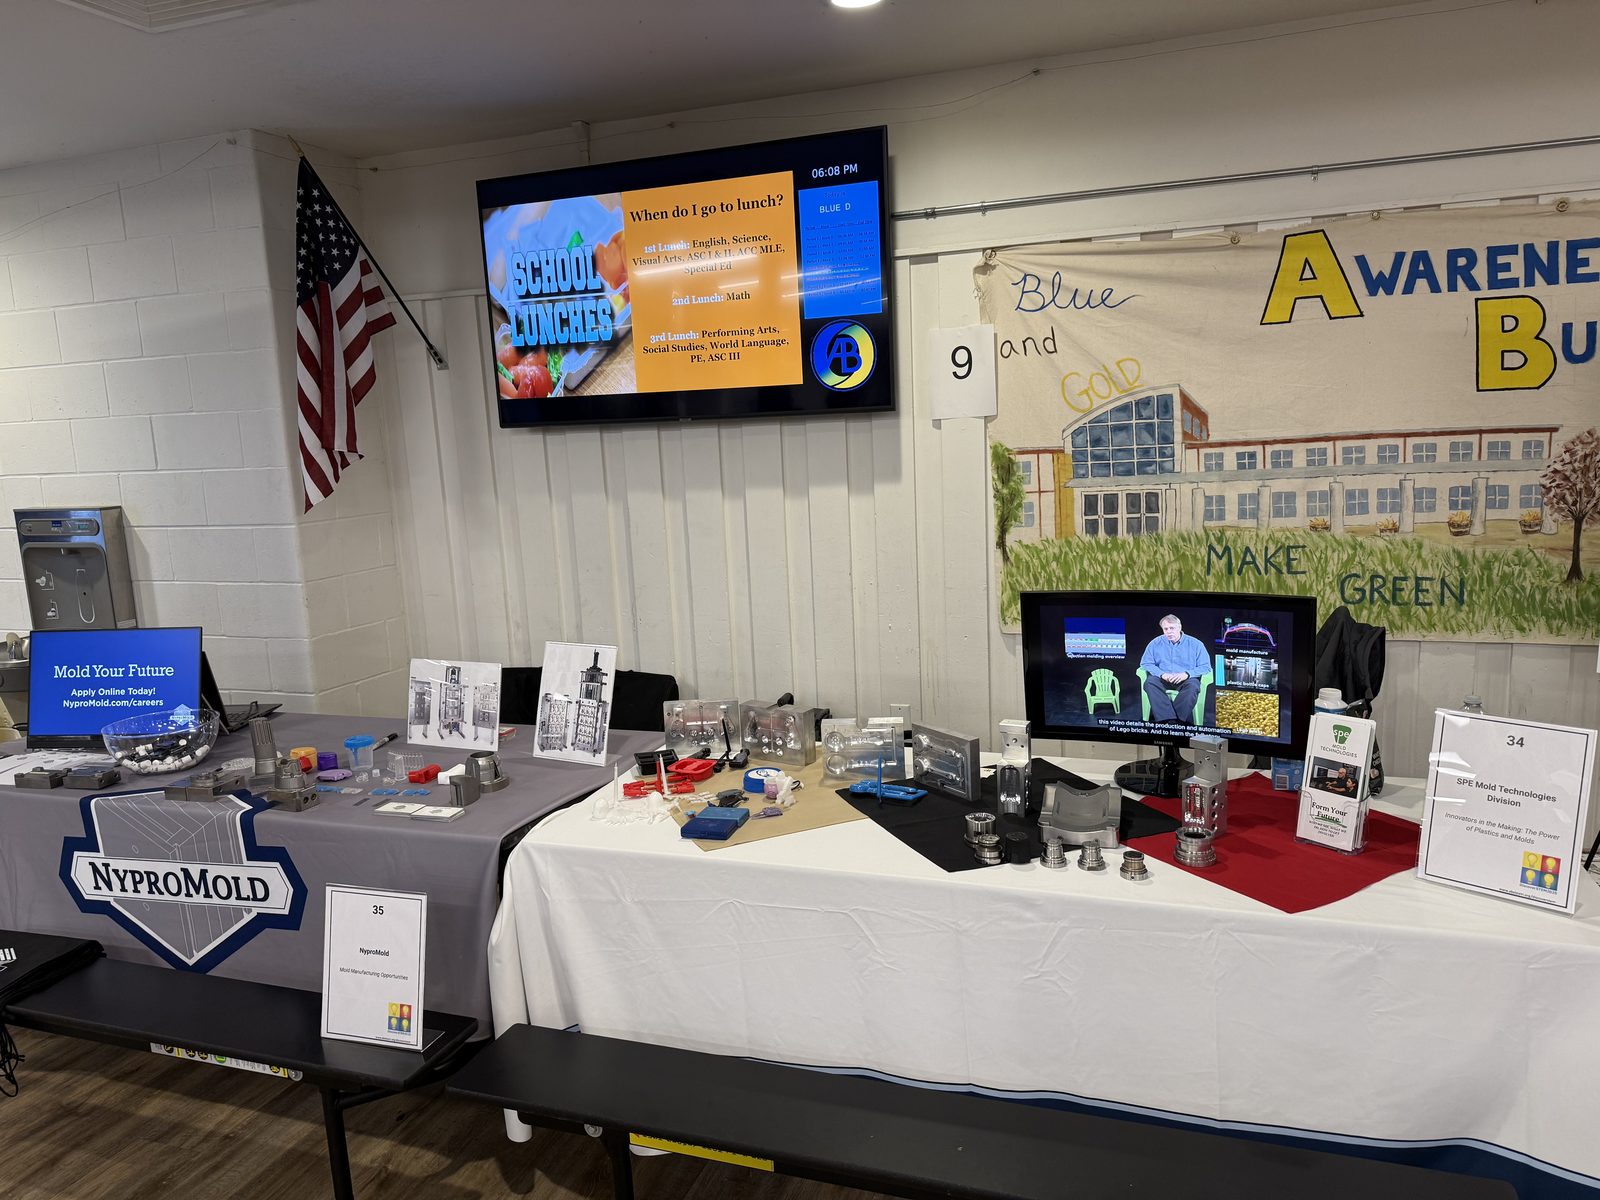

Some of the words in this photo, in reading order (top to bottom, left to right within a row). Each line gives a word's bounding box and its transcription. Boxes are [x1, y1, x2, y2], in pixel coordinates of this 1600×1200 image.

[812, 166, 840, 178] 06:08
[844, 163, 858, 174] PM
[630, 209, 668, 222] When
[672, 206, 688, 218] do
[692, 204, 698, 216] I
[701, 205, 717, 218] go
[720, 202, 733, 212] to
[737, 194, 784, 210] lunch?
[820, 204, 840, 213] BLUE
[644, 244, 656, 253] 1st
[658, 240, 690, 252] Lunch:
[692, 236, 730, 249] English,
[732, 233, 771, 244] Science,
[633, 255, 661, 266] Visual
[662, 254, 685, 264] Arts,
[687, 251, 706, 261] ASC
[708, 250, 712, 259] I
[714, 250, 722, 259] &
[738, 246, 758, 256] ACC
[760, 244, 785, 255] MLE,
[511, 245, 601, 296] SCHOOL
[684, 263, 717, 275] Special
[720, 261, 732, 271] Ed
[1260, 228, 1600, 325] AWARENE
[672, 296, 690, 306] 2nd
[692, 293, 724, 304] Lunch:
[726, 291, 750, 301] Math
[1011, 271, 1144, 312] Blue
[508, 299, 613, 347] LUNCHES
[650, 332, 666, 343] 3rd
[668, 331, 699, 341] Lunch:
[702, 327, 755, 339] Performing
[757, 326, 780, 335] Arts,
[1000, 326, 1058, 359] and
[643, 345, 669, 354] Social
[672, 343, 708, 353] Studies,
[710, 340, 739, 350] World
[742, 338, 789, 349] Language,
[1475, 295, 1598, 392] BU
[690, 354, 706, 363] PE,
[708, 353, 726, 362] ASC
[729, 352, 740, 360] III
[951, 346, 973, 379] 9
[1061, 358, 1144, 413] GOLD
[1207, 544, 1307, 576] MAKE
[1340, 572, 1465, 606] GREEN
[54, 665, 91, 678] Mold
[92, 665, 125, 677] Your
[128, 664, 174, 677] Future
[71, 688, 96, 697] Apply
[98, 688, 125, 696] Online
[128, 687, 156, 696] Today!
[63, 698, 164, 708] NyproMold.com/careers
[1333, 729, 1349, 743] spe
[1507, 735, 1524, 748] 34
[1320, 746, 1357, 758] TECHNOLOGIES
[1457, 778, 1473, 787] SPE
[1475, 781, 1496, 791] Mold
[1498, 784, 1557, 802] Technologies
[1487, 794, 1521, 807] Division
[1312, 802, 1330, 812] Form
[1331, 807, 1347, 817] Your
[1317, 811, 1340, 822] Future
[1445, 812, 1477, 824] Innovators
[1497, 822, 1523, 834] Making:
[1524, 828, 1537, 836] The
[1538, 830, 1560, 840] Power
[1474, 827, 1499, 837] Plastics
[1514, 835, 1535, 845] Molds
[88, 862, 270, 902] NYPROMOLD
[372, 905, 384, 915] 35
[359, 947, 389, 957] NyproMold
[351, 968, 380, 978] Manufacturing
[381, 972, 408, 981] Opportunities
